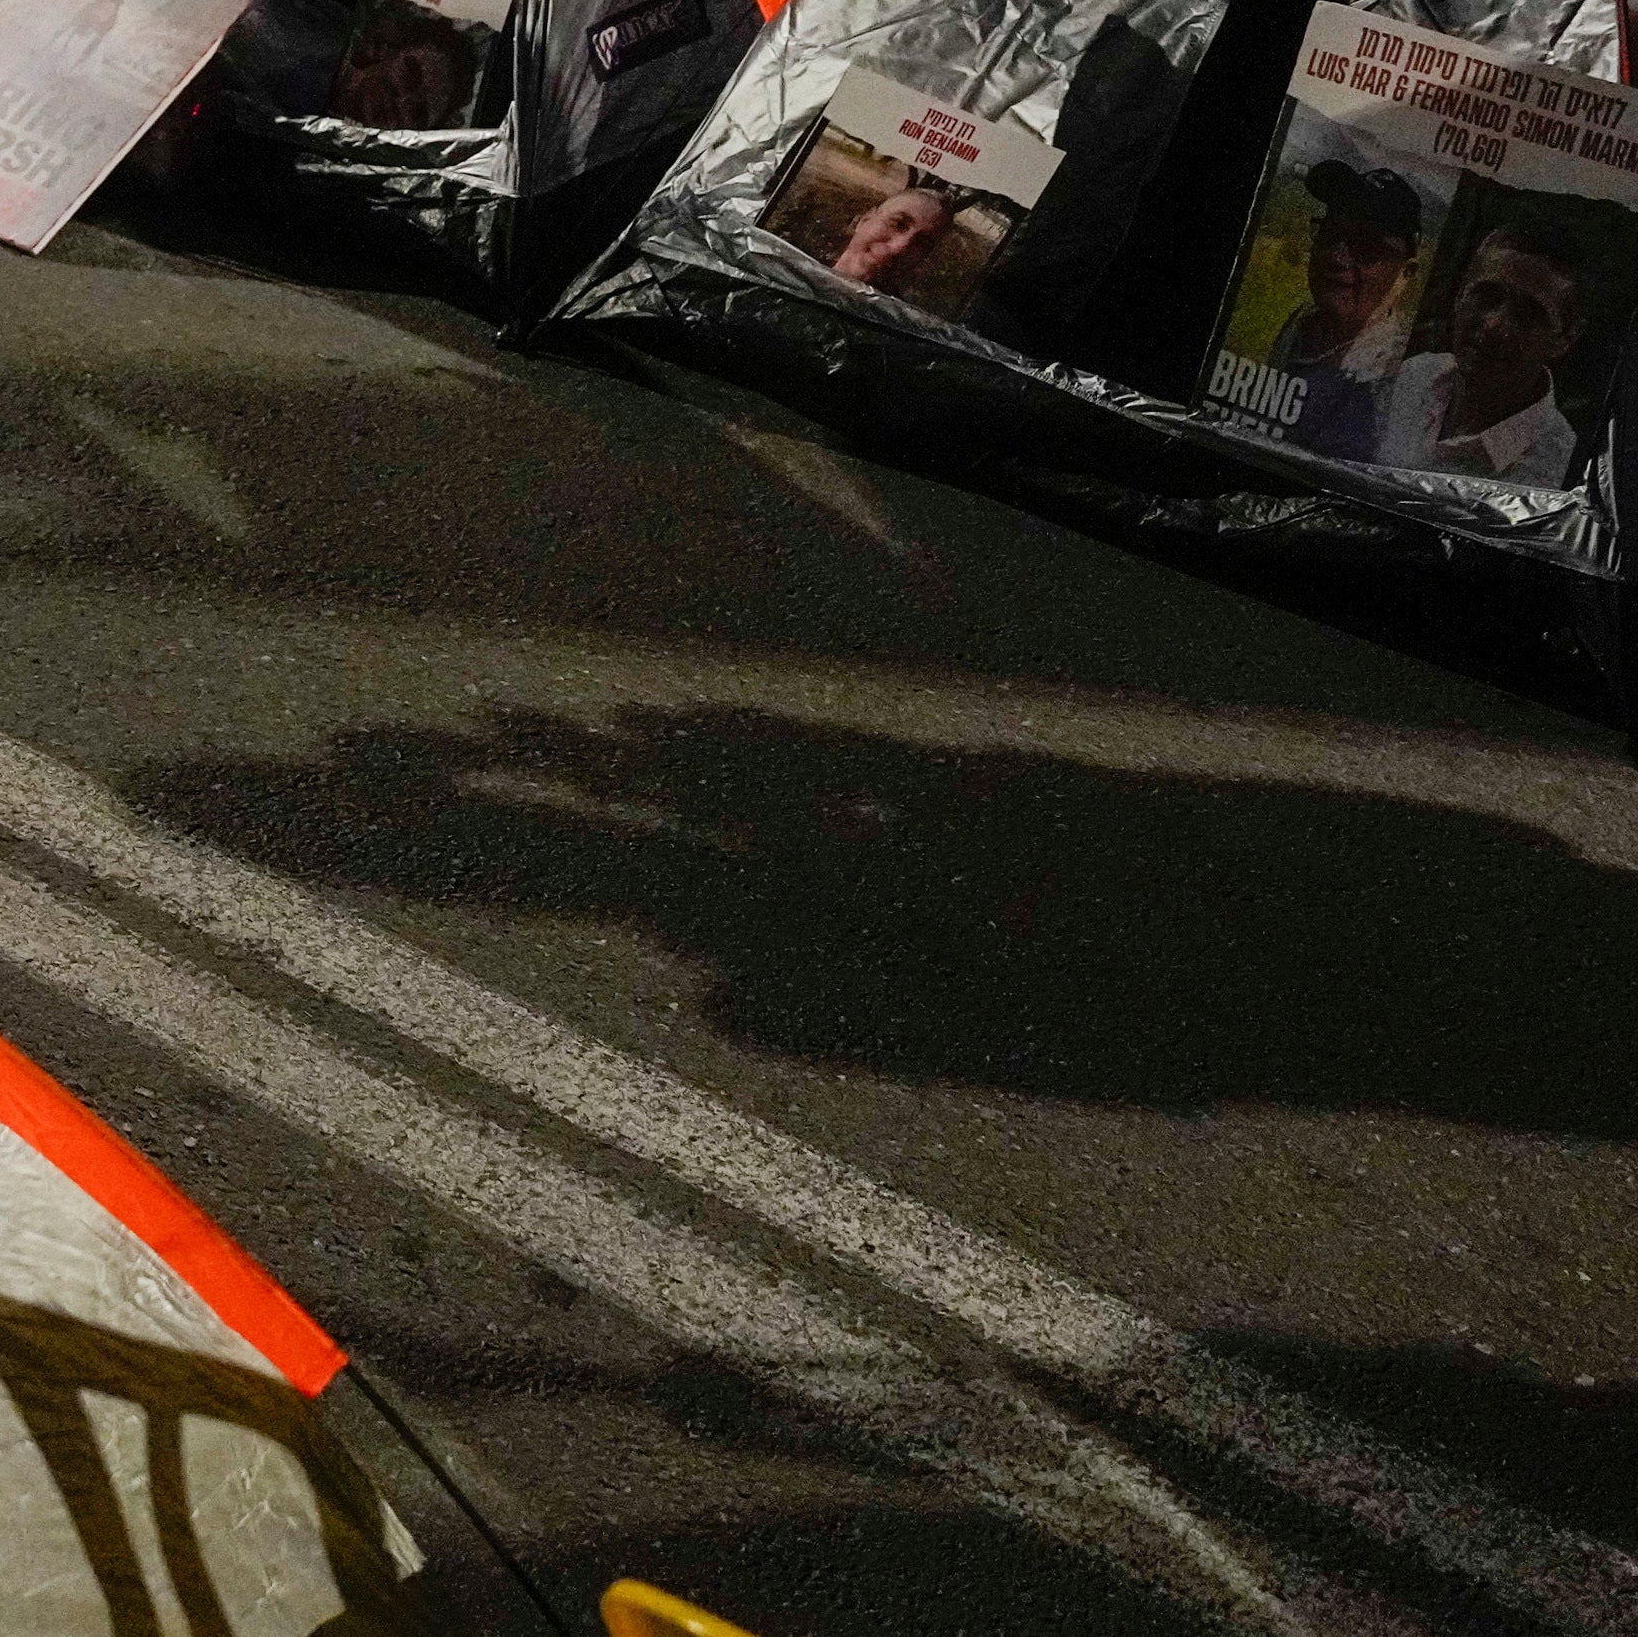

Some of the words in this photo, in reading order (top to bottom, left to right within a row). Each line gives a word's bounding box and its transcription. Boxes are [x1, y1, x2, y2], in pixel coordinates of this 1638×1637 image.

[1355, 26, 1405, 66] מרמן
[1404, 41, 1459, 80] סימון
[1306, 48, 1350, 85] LUIS
[1349, 61, 1393, 102] HAR
[1410, 79, 1512, 133] FERNANDO
[1511, 109, 1582, 153] SIMON
[1459, 56, 1534, 103] ופרננדו
[1537, 76, 1565, 112] הר
[921, 108, 959, 134] בנימין
[1565, 85, 1629, 129] לואיס
[898, 119, 925, 140] RON
[922, 129, 981, 163] BENJAMIN
[955, 122, 977, 141] רון
[1433, 120, 1508, 173] (70,60)
[914, 146, 943, 169] (53)
[1208, 349, 1309, 426] BRING
